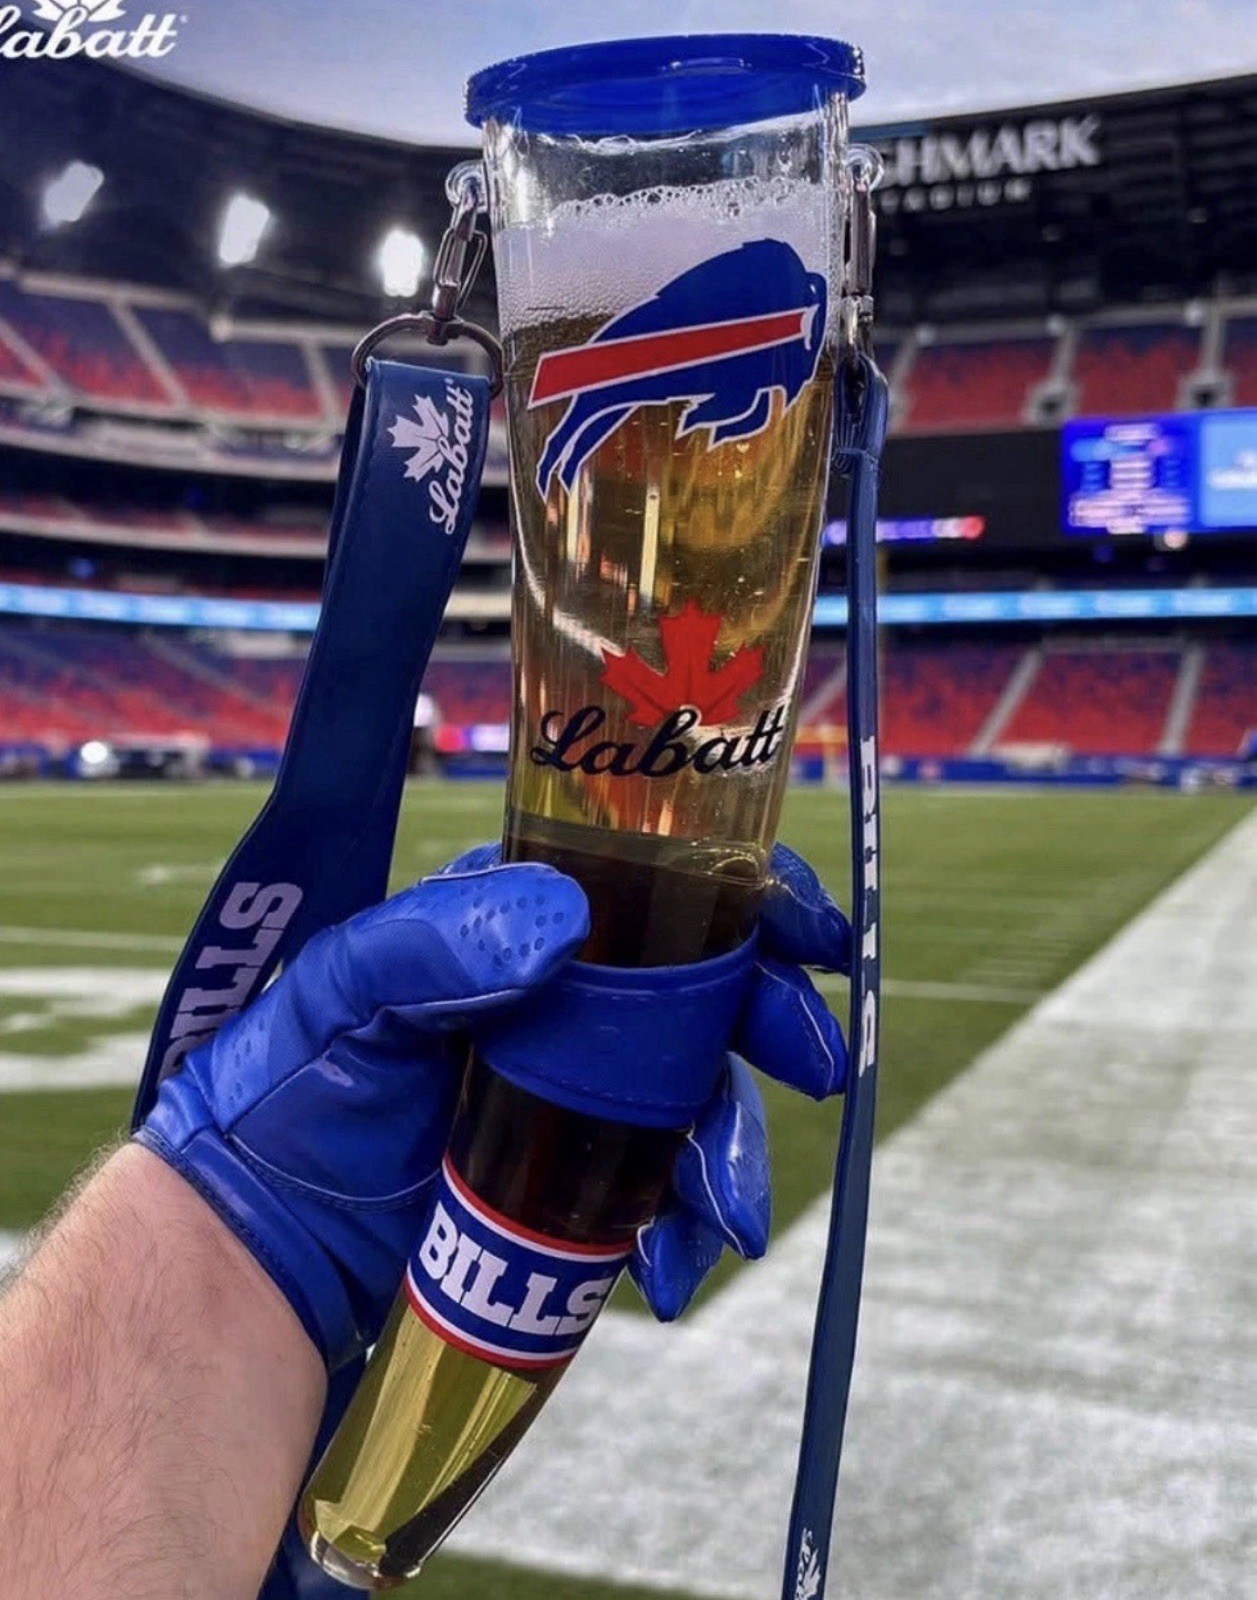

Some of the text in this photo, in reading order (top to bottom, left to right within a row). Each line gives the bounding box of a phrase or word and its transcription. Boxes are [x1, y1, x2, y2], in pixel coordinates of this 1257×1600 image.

[429, 385, 474, 535] Labatt
[530, 705, 784, 777] Labatt
[419, 1200, 615, 1336] BILLS
